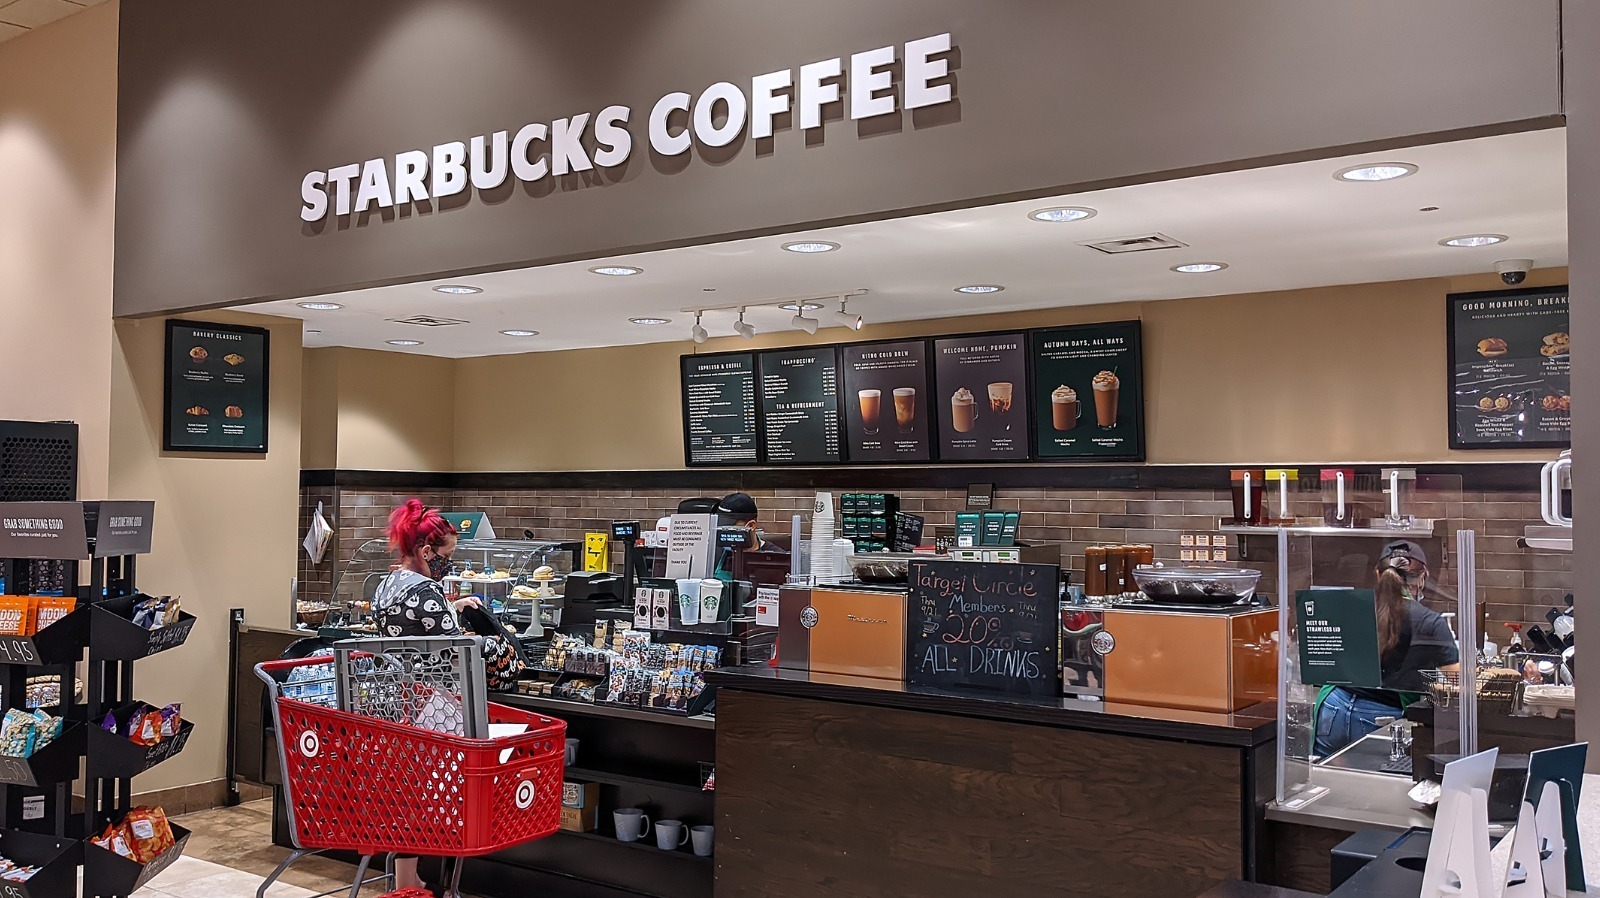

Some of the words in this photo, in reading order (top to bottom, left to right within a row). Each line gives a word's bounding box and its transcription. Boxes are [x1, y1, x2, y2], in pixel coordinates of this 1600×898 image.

[300, 104, 632, 222] STARBUCKS
[647, 33, 952, 156] COFFEE
[1462, 302, 1485, 311] GOOD
[1489, 299, 1533, 309] MORNING,
[192, 331, 214, 339] BAKERY
[216, 333, 242, 341] CLASSICS
[970, 345, 988, 353] HOME,
[990, 343, 1017, 351] PUMPKIN
[1044, 341, 1069, 349] AUTUMN
[1071, 339, 1090, 347] DAYS,
[1106, 337, 1124, 345] WAYS
[3, 518, 18, 529] GRAB
[18, 518, 48, 530] SOMETHING
[48, 518, 64, 530] GOOD
[913, 563, 966, 597] Target
[920, 595, 936, 607] Thru
[949, 594, 1006, 613] Members
[0, 609, 22, 620] OON
[38, 608, 68, 620] MOON
[921, 644, 957, 675] ALL
[969, 645, 1040, 679] DRINKS
